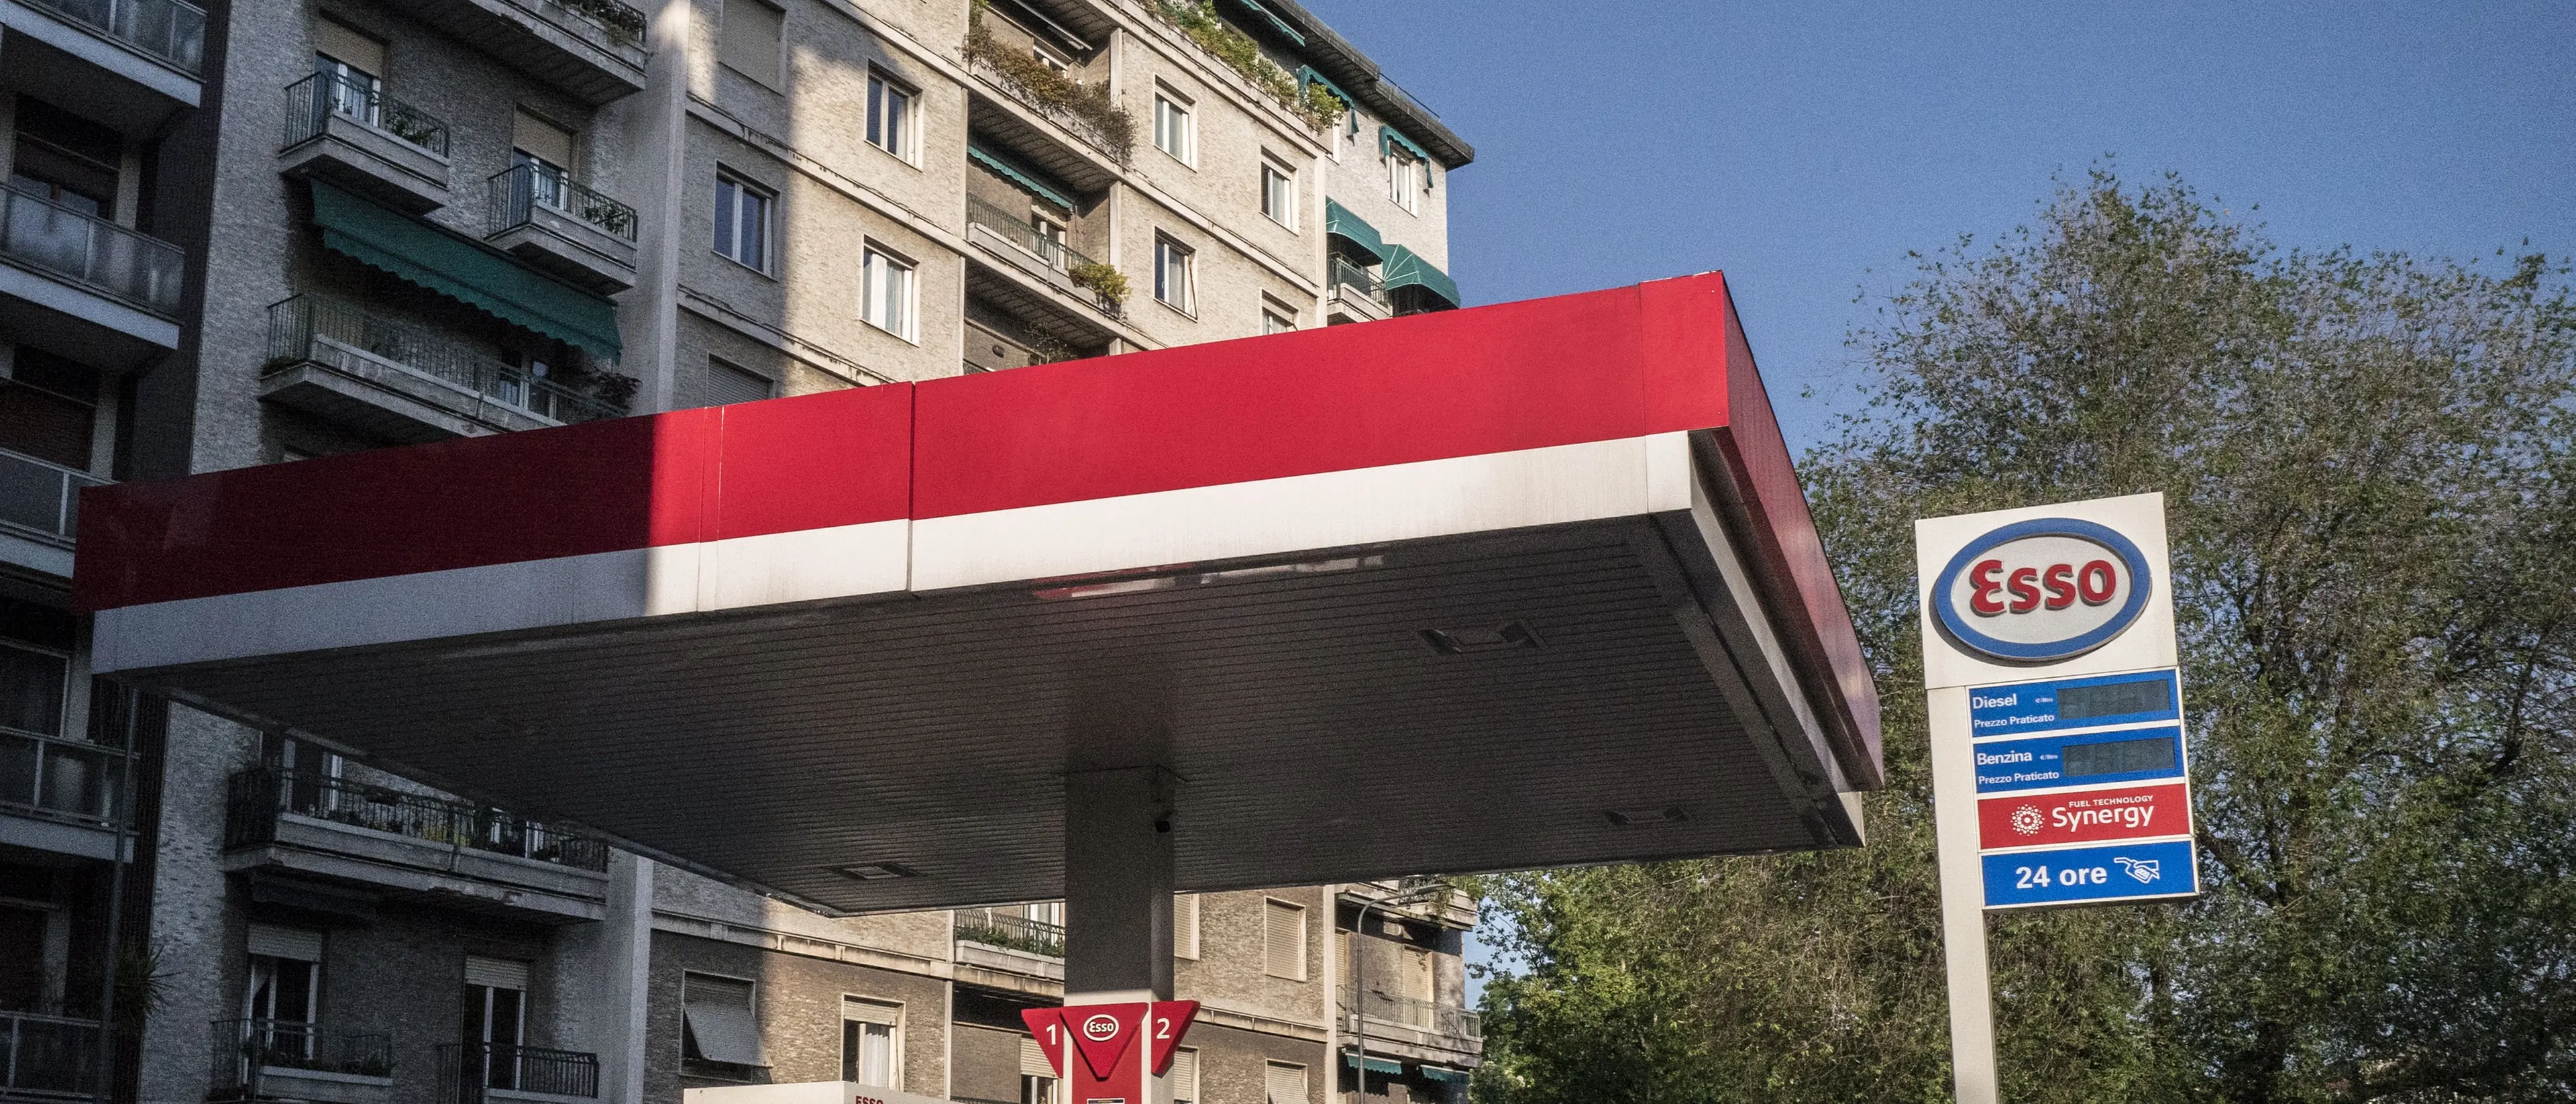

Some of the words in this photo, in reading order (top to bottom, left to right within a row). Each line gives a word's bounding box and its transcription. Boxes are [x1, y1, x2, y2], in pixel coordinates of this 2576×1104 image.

[1972, 693, 2017, 709] Diesel
[1974, 718, 2007, 728] Prezzo
[2010, 714, 2055, 725] Praticato
[1977, 750, 2033, 765] Benzina
[1979, 775, 2012, 785] Prezzo
[2014, 772, 2059, 782] Praticato
[2092, 795, 2153, 806] TECHNOLOGY
[2052, 805, 2154, 832] Synergy
[2016, 866, 2050, 889] 24
[2059, 866, 2107, 886] ore
[1046, 1024, 1057, 1045] 1
[1156, 1017, 1170, 1039] 2
